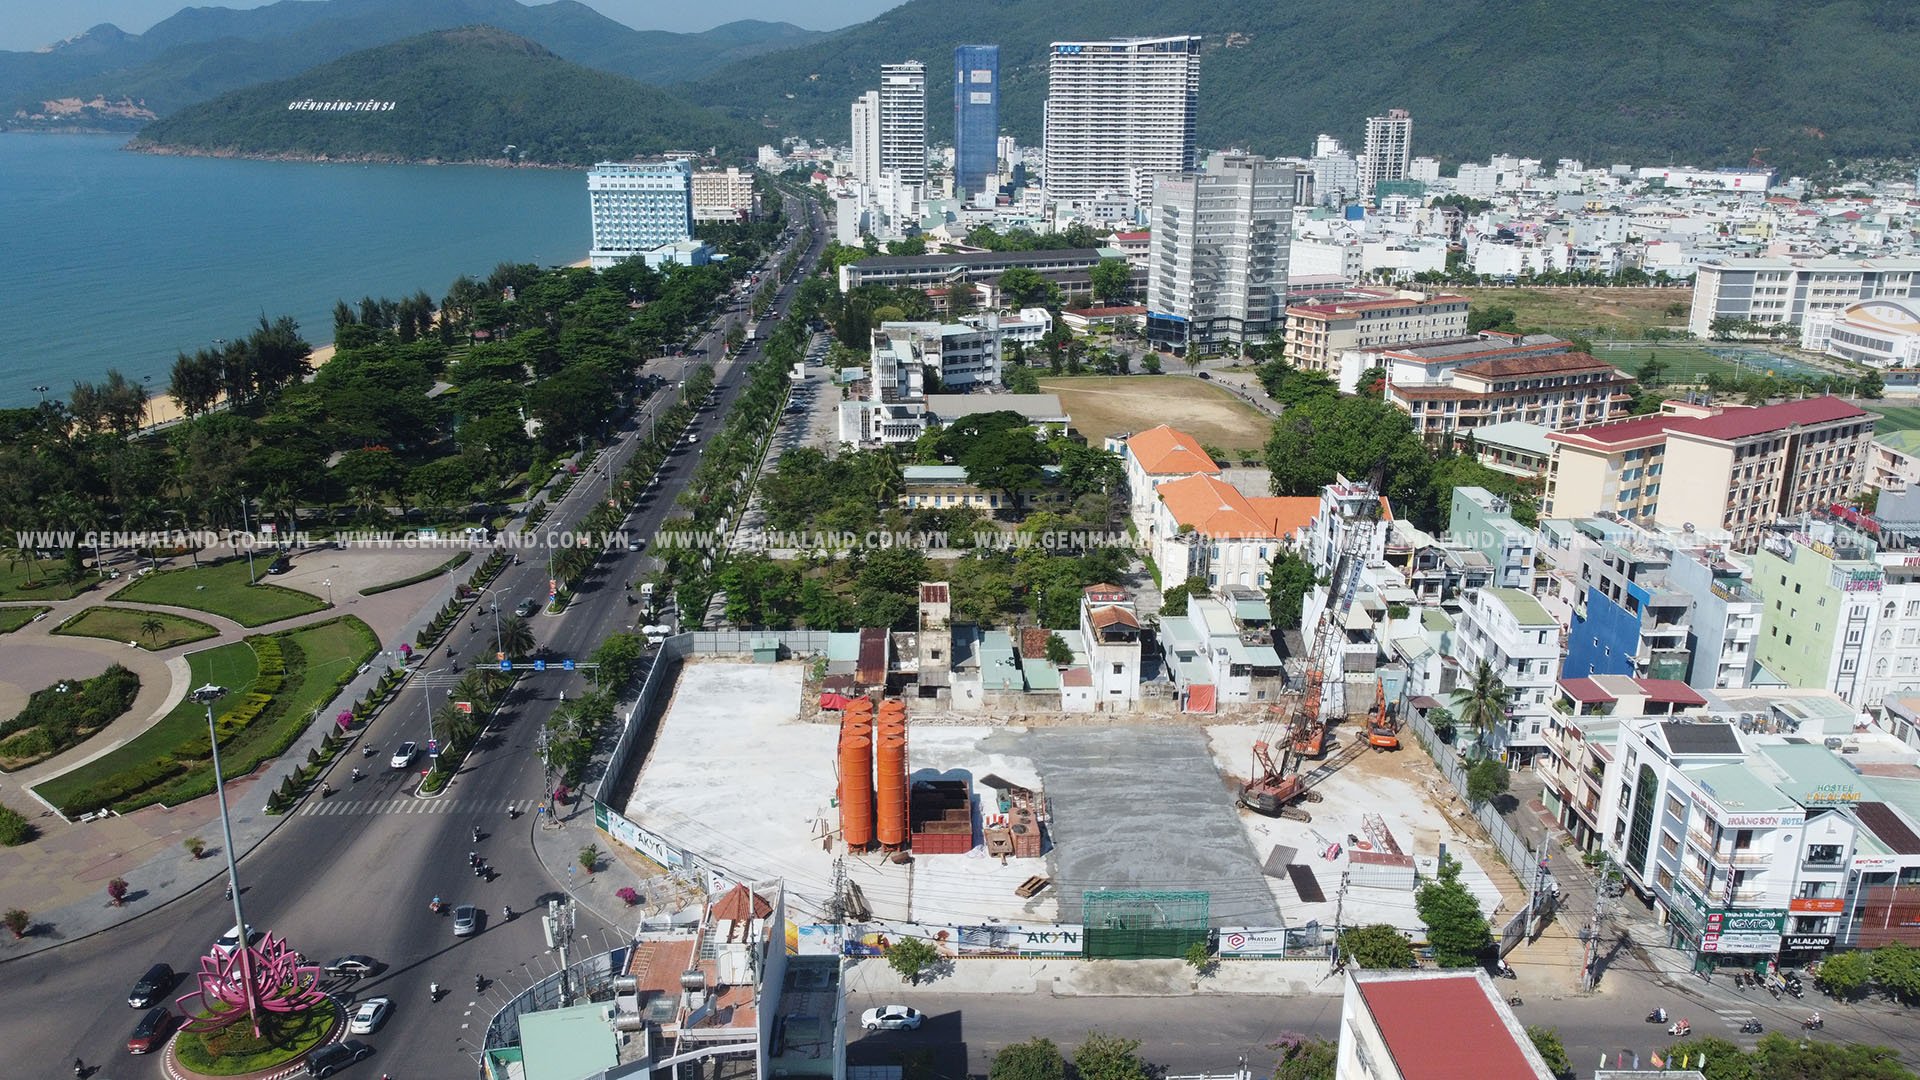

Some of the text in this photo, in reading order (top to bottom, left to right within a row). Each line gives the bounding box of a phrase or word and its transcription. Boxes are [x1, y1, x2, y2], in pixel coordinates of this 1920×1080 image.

[382, 101, 396, 111] SA
[1817, 784, 1854, 792] HOSTEL
[1728, 816, 1804, 826] HOÀNG SƠN HOTEL
[1027, 932, 1077, 943] AKYN
